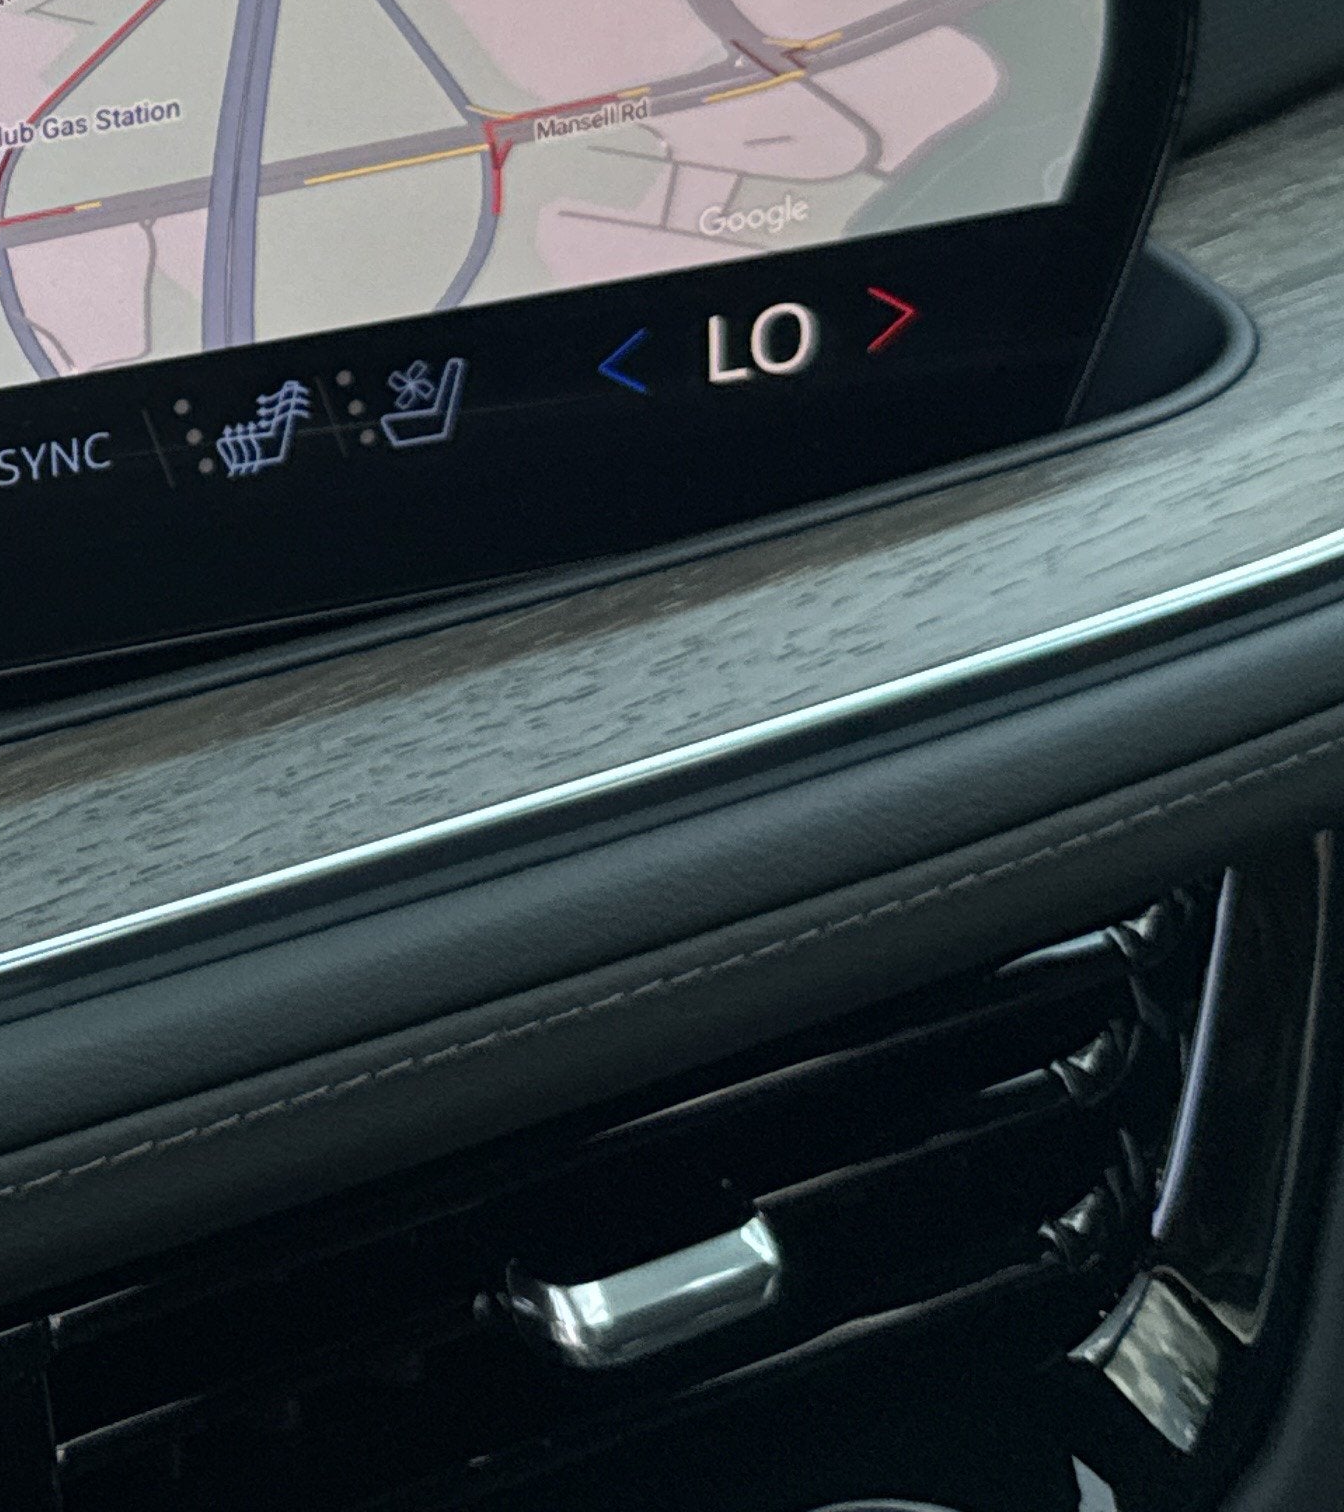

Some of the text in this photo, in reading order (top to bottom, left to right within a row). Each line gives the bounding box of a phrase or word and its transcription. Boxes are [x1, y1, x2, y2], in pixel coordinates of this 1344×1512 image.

[41, 115, 89, 143] Gas
[96, 99, 182, 130] Station
[535, 100, 649, 140] Mansell Rd
[698, 194, 811, 237] Google
[707, 301, 817, 385] LO
